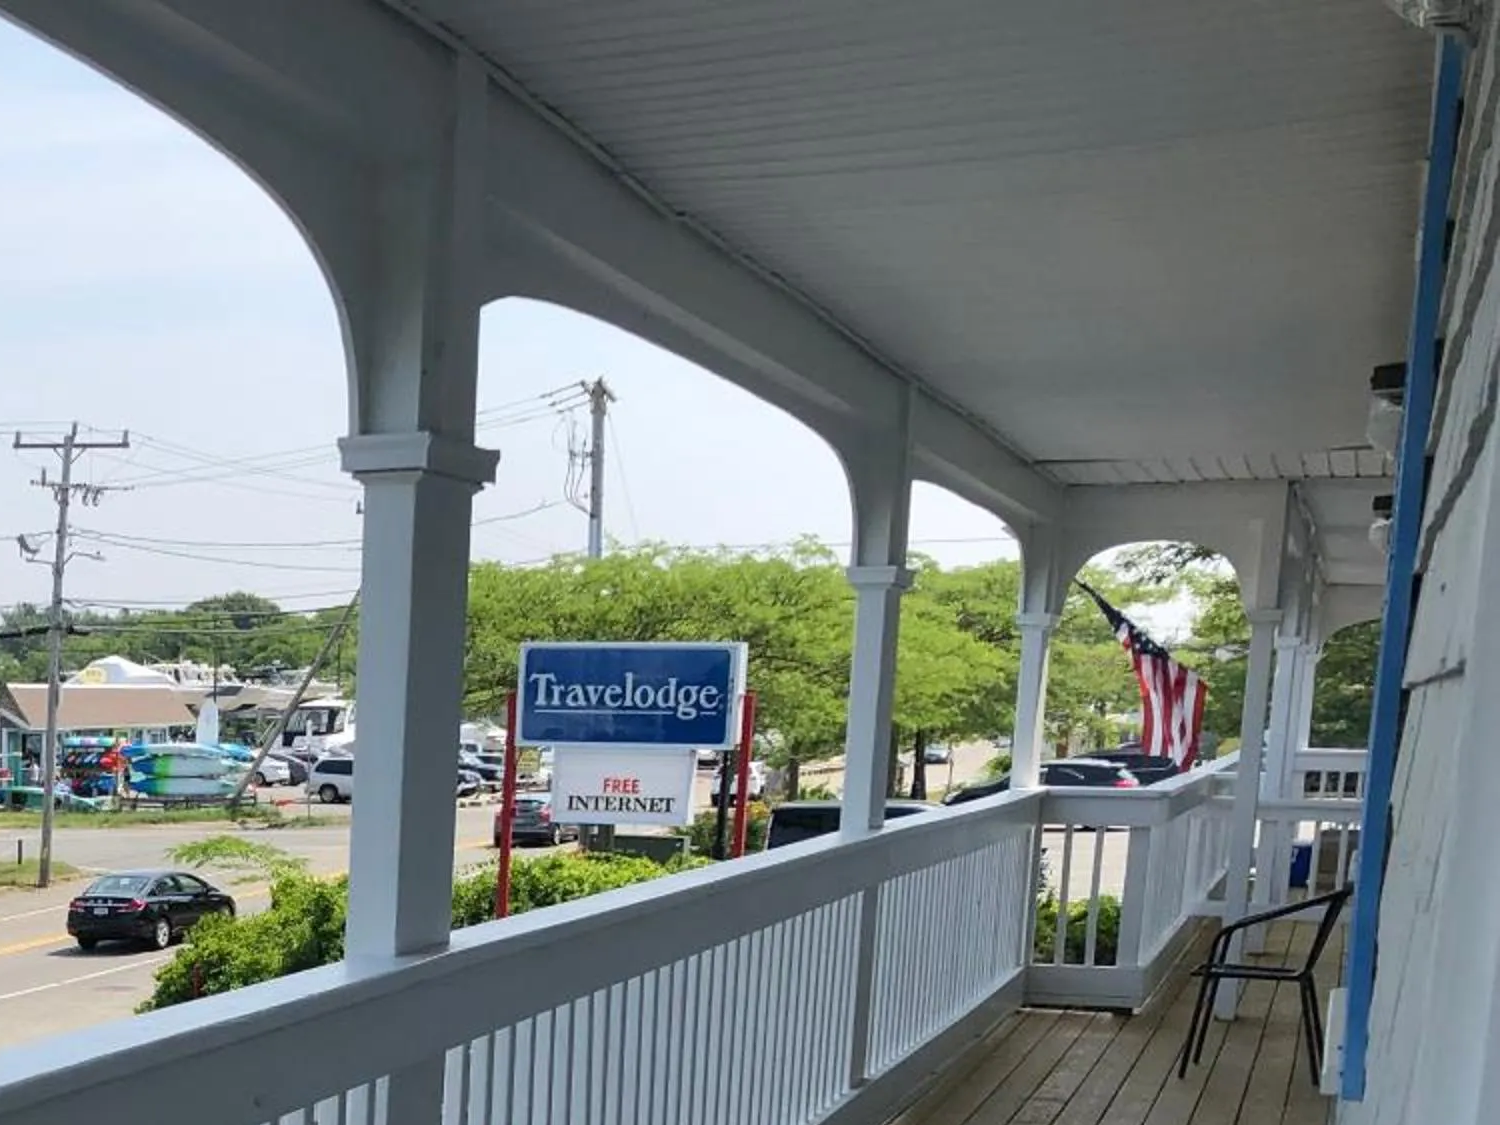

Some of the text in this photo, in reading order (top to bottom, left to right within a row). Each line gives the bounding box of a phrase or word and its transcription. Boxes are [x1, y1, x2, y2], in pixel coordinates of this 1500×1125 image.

[529, 671, 724, 720] Travelodge
[603, 777, 641, 795] FREE
[567, 795, 676, 814] INTERNET
